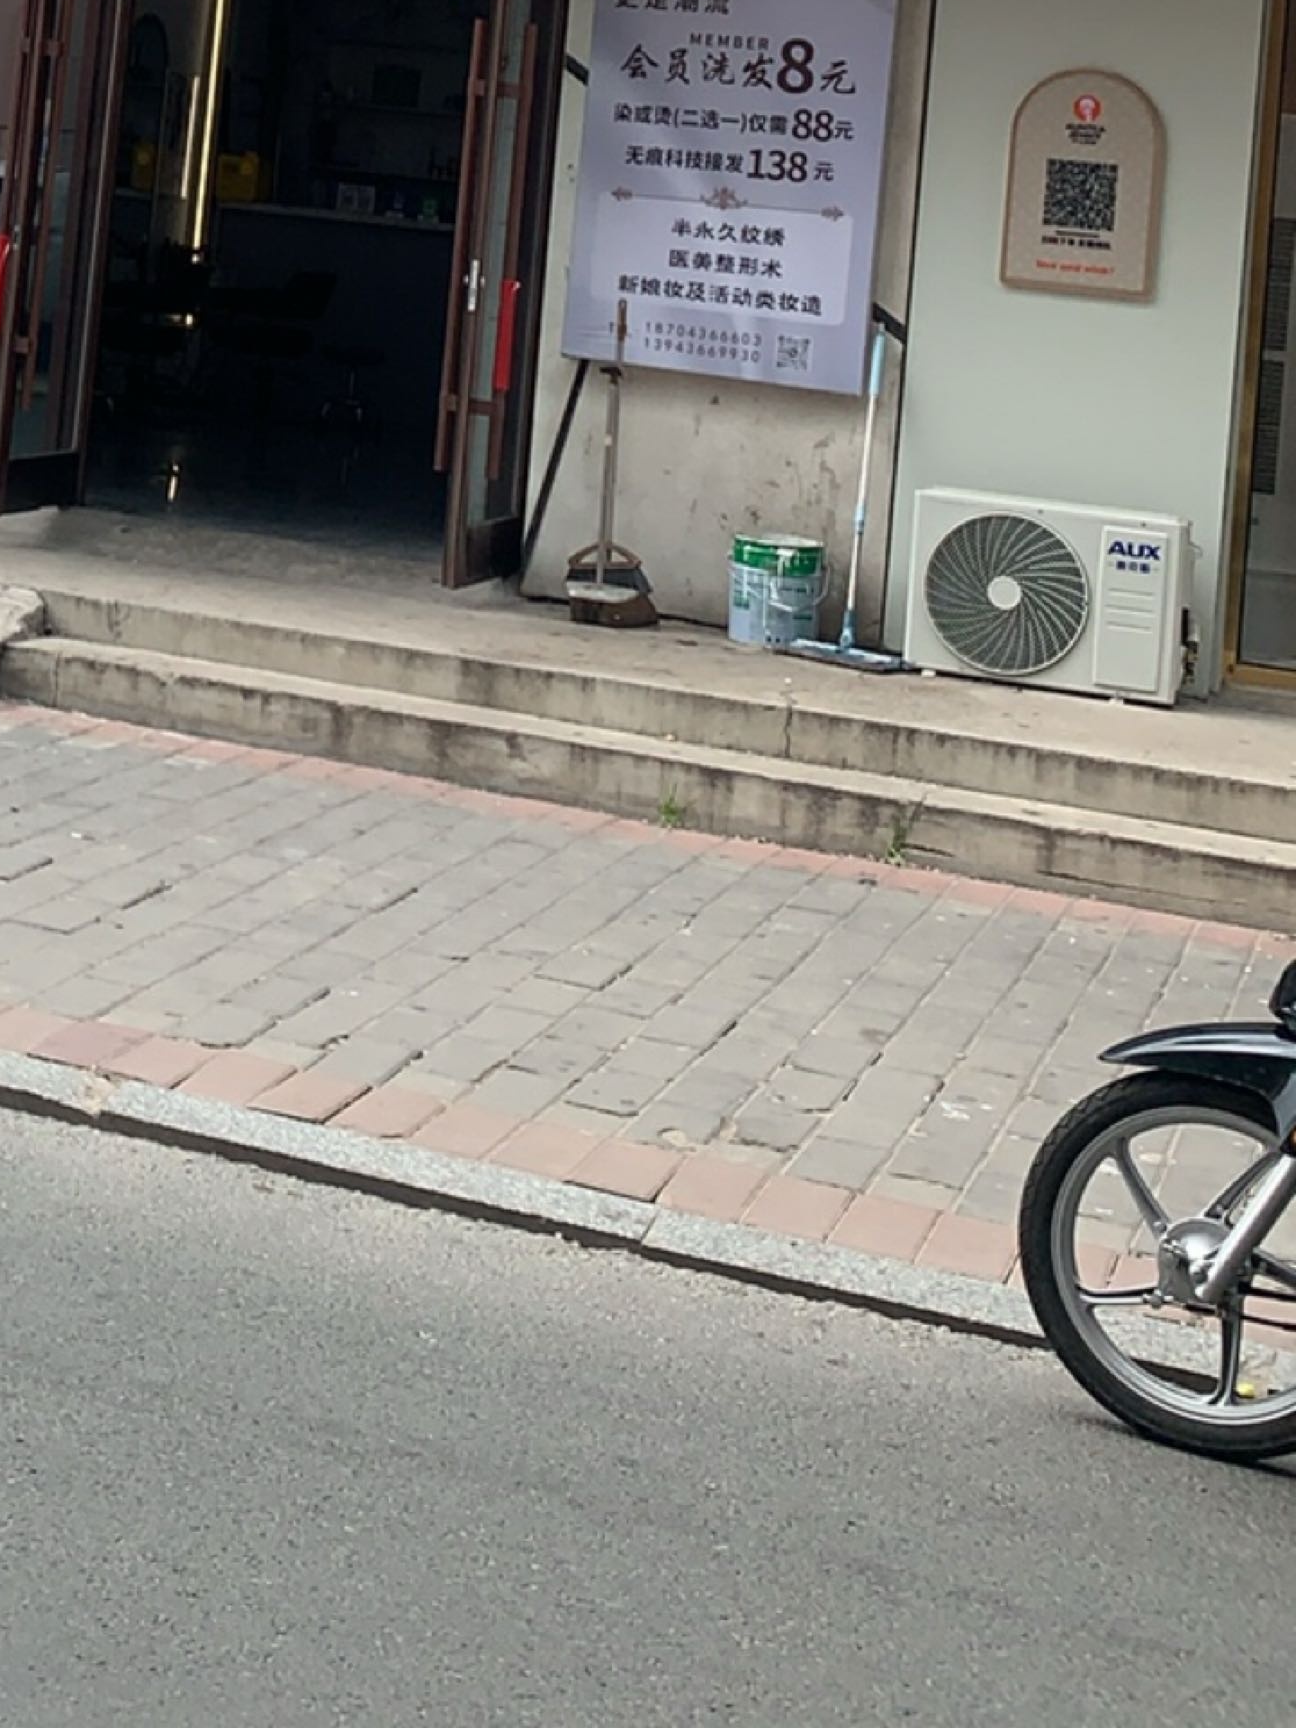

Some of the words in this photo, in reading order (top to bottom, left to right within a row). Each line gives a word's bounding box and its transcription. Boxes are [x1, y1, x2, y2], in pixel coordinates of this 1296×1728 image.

[689, 33, 770, 51] MEMBER
[671, 218, 785, 247] 半永久纹绣
[1108, 540, 1161, 561] AUX
